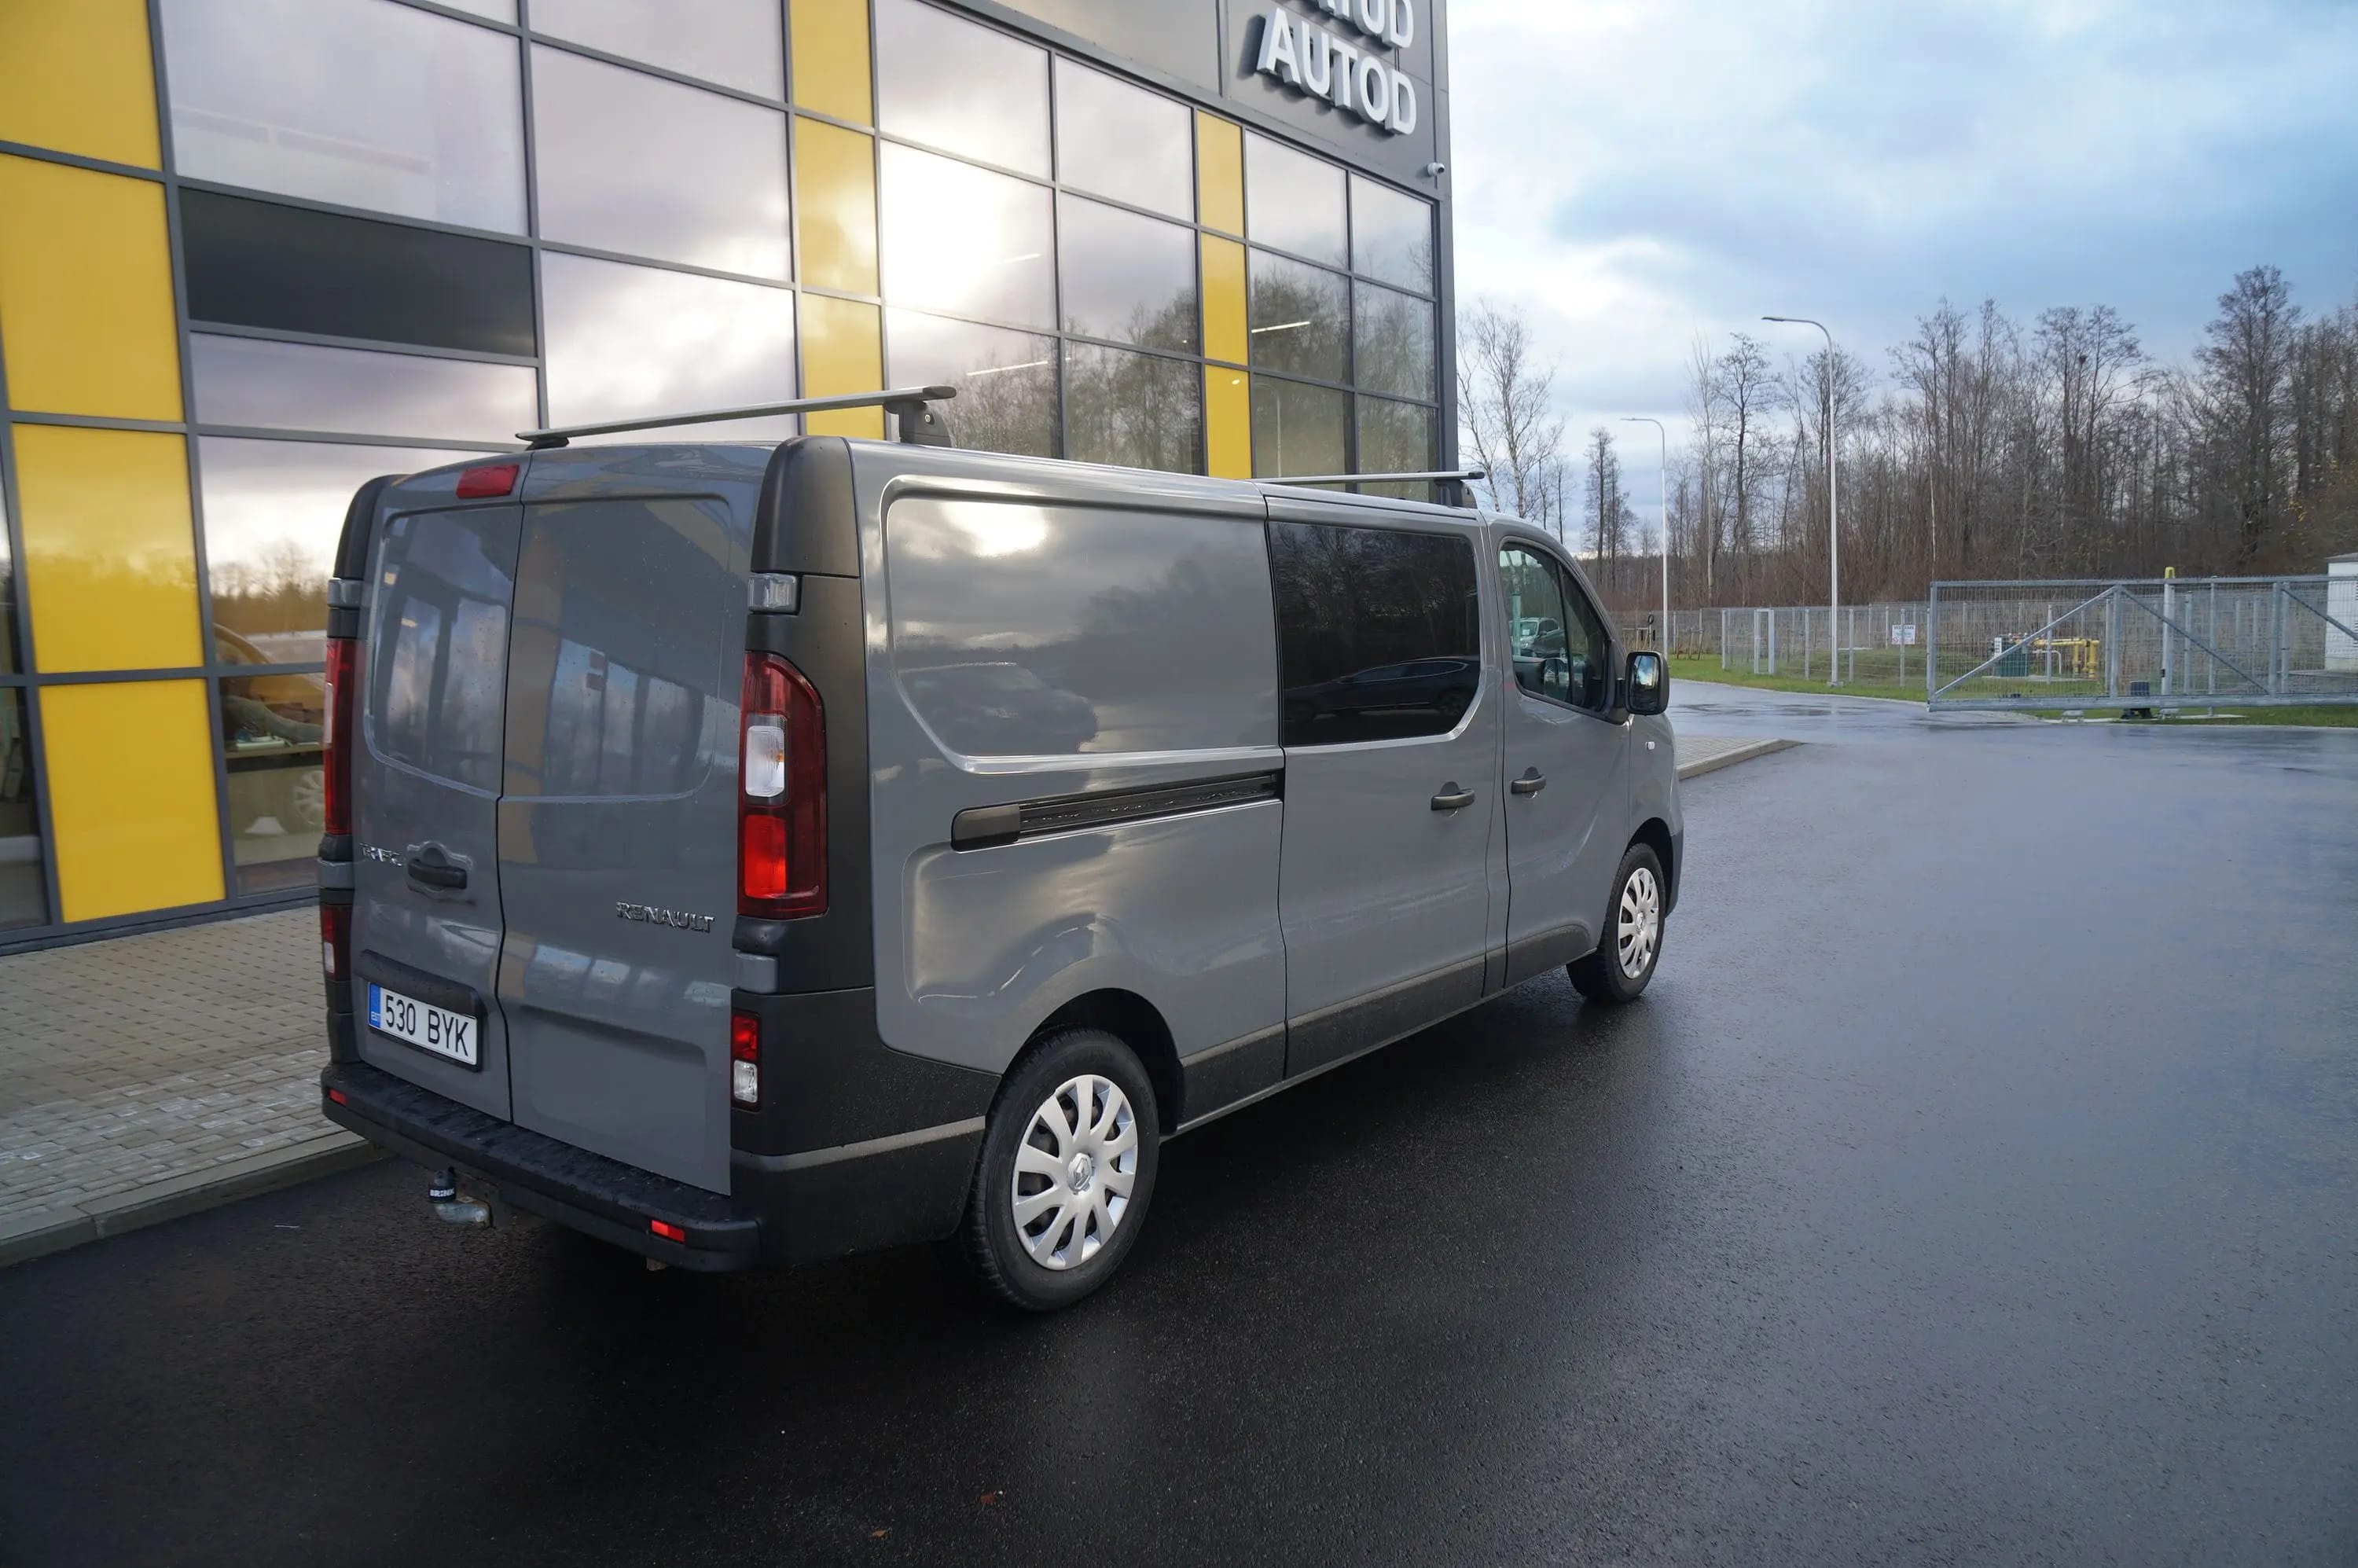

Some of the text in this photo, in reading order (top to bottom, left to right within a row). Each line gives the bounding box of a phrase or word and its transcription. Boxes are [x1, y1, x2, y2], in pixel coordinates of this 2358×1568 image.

[1257, 7, 1416, 135] AUTOD
[616, 901, 714, 933] RENAULT
[385, 994, 468, 1056] 530 BYK
